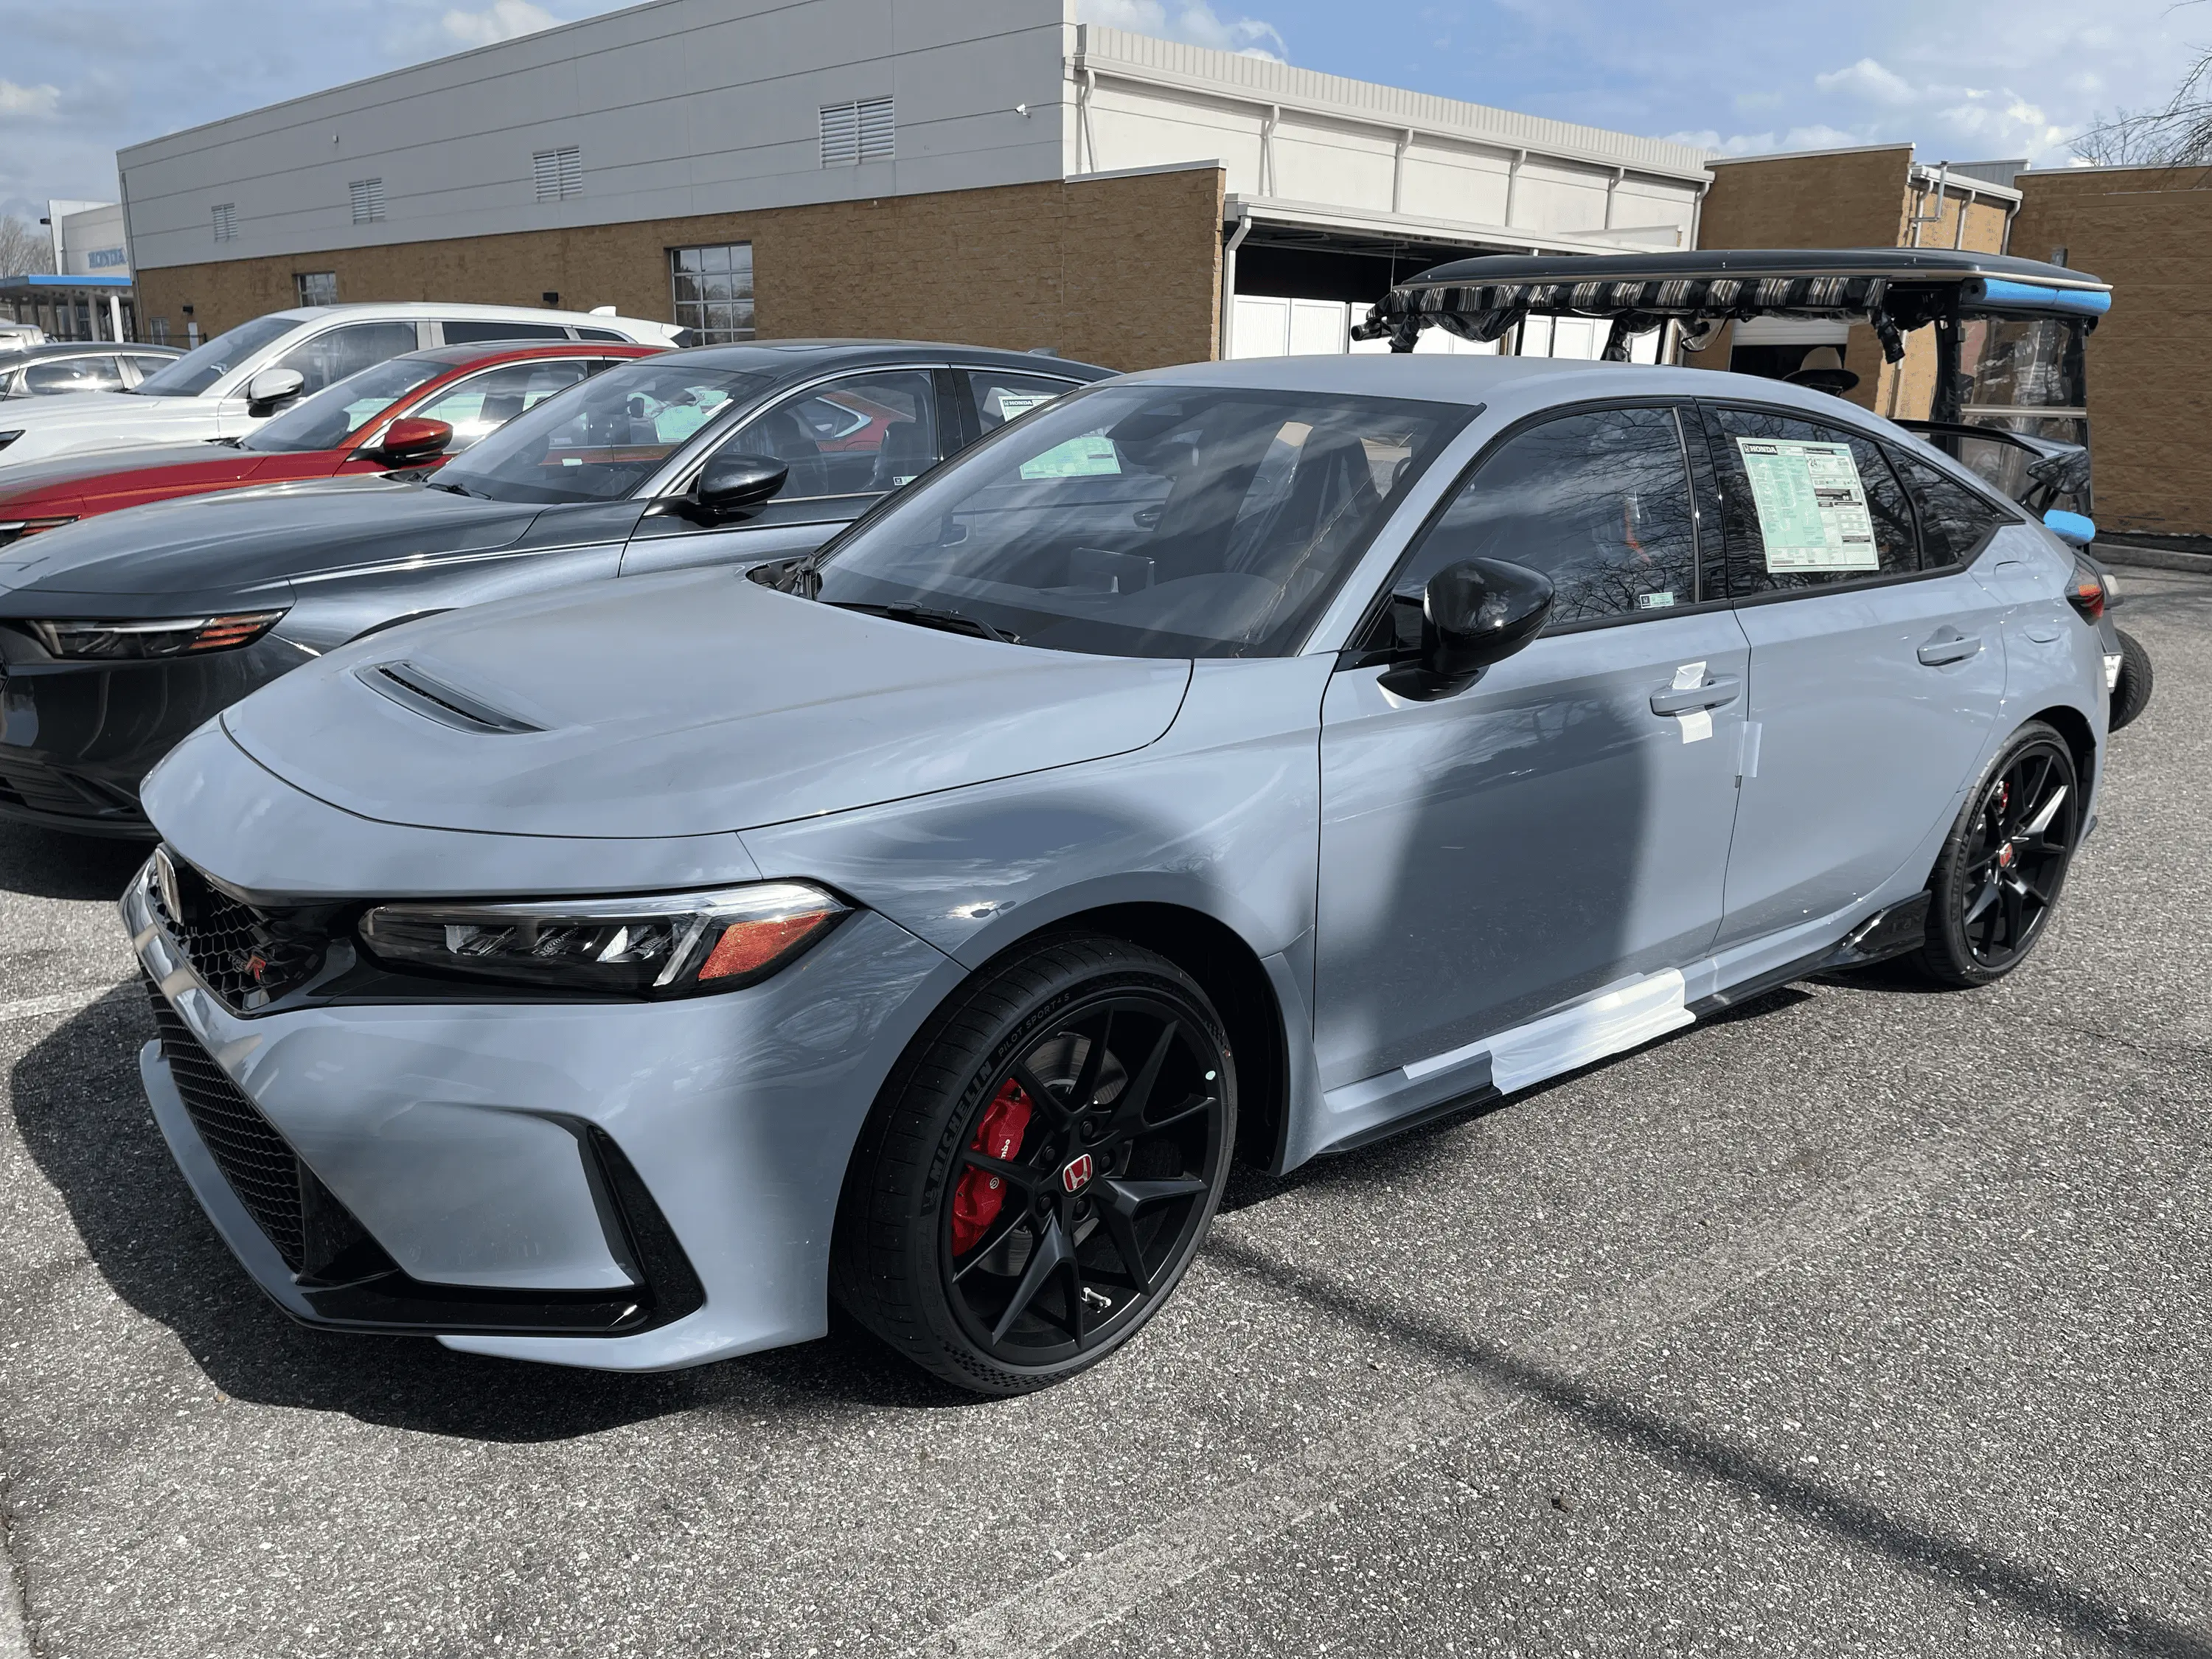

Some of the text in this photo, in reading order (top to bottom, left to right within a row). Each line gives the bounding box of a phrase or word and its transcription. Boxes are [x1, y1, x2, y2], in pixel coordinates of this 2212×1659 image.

[88, 248, 127, 268] HONDA
[1750, 445, 1778, 454] HONDA
[998, 1027, 1023, 1057] PILOT
[929, 1060, 993, 1180] MICHELIN
[1001, 1138, 1010, 1159] mbo
